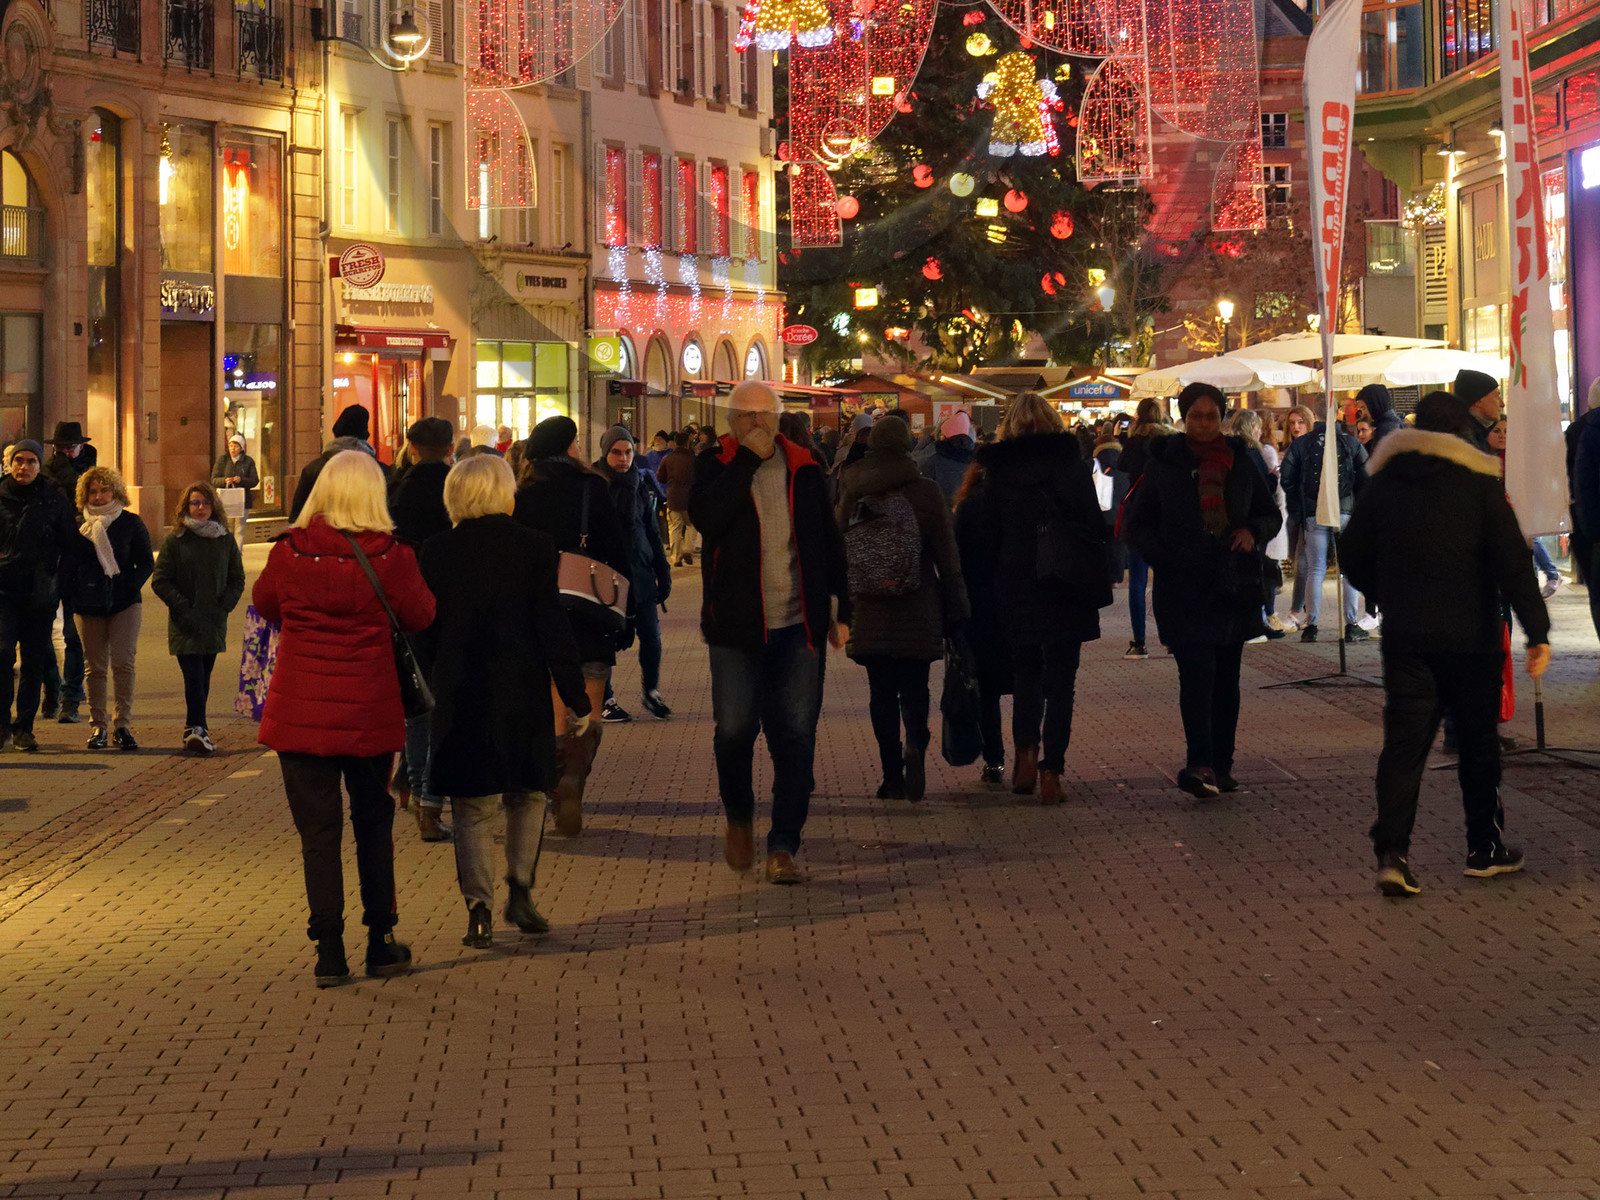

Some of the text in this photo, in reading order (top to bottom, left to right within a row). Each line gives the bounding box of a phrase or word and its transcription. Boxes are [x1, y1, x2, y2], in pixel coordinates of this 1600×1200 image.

[1474, 221, 1496, 262] PAUL
[341, 255, 380, 271] FRESH
[1433, 245, 1447, 279] P
[343, 264, 381, 277] BURRITOS
[525, 275, 567, 289] YVES ROCHER
[787, 333, 813, 341] Dorée
[1074, 384, 1103, 395] unicef
